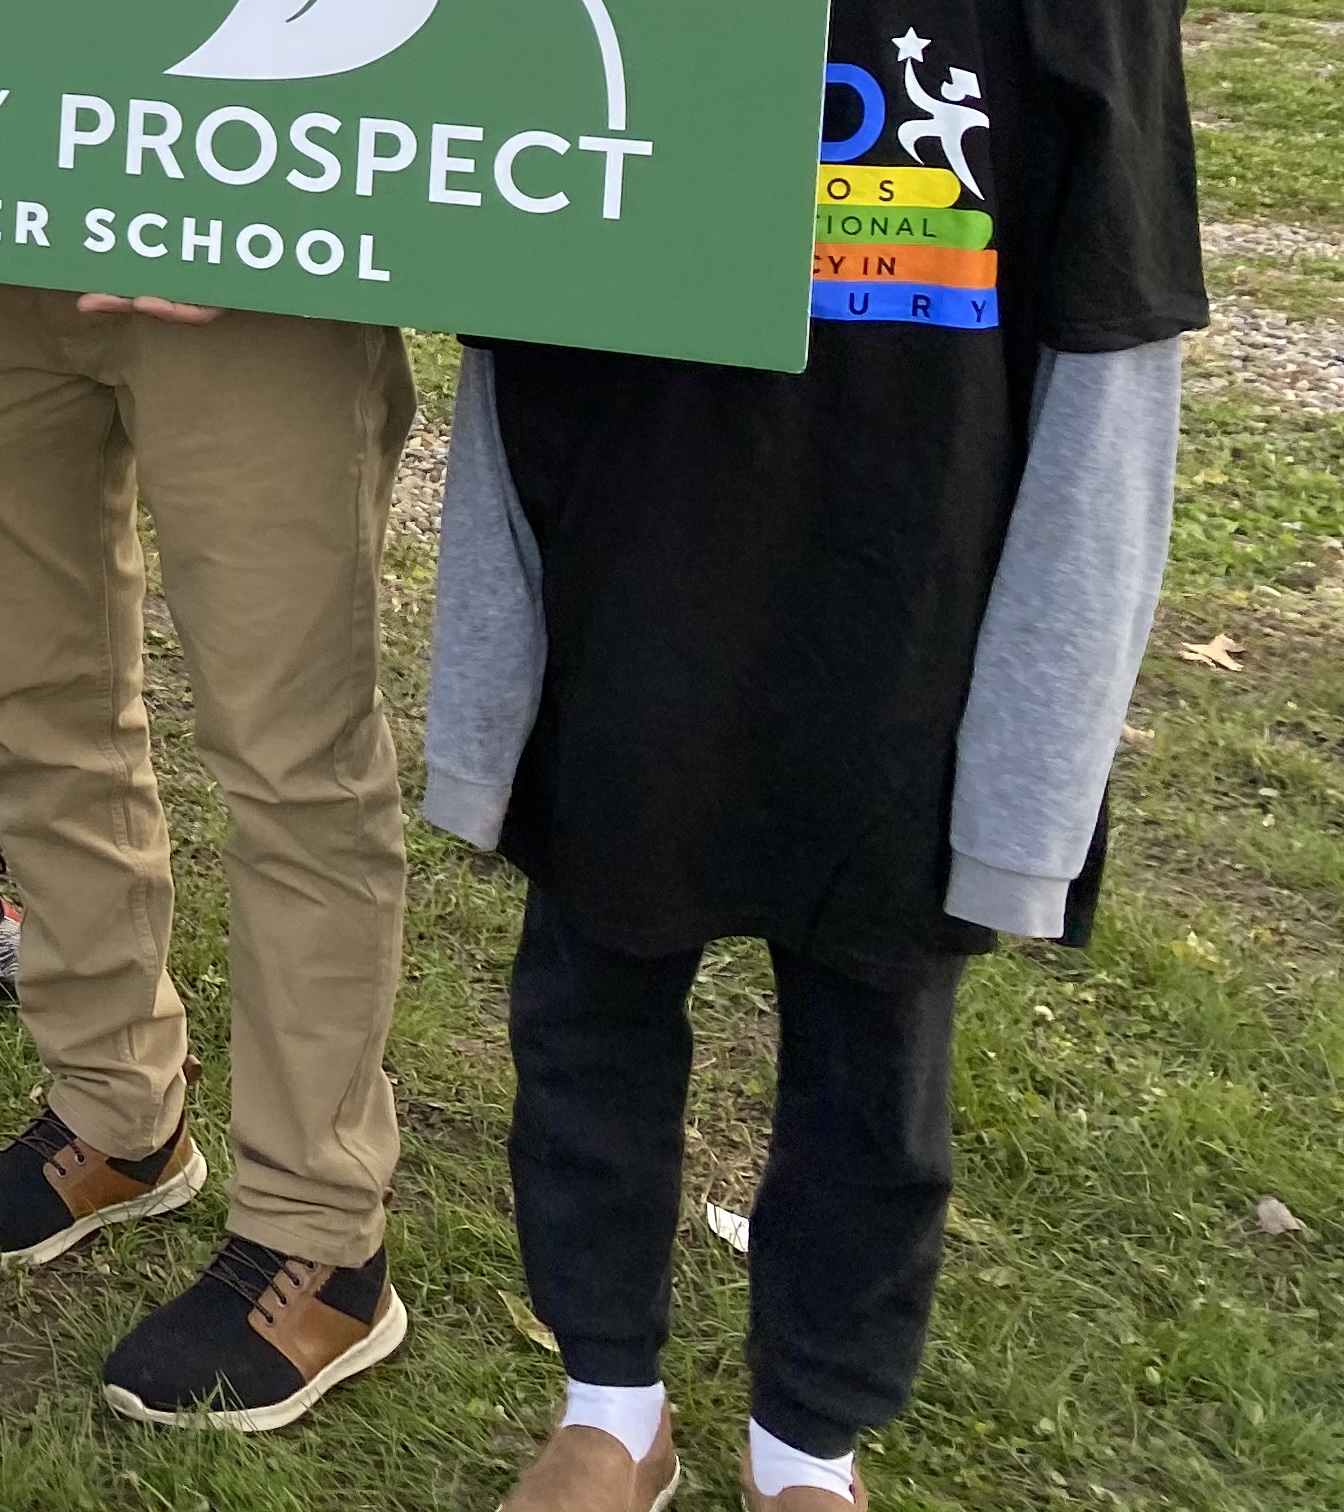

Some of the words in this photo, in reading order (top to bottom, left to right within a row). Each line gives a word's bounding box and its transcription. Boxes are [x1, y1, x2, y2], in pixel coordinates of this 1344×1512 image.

[57, 93, 653, 222] PROSPECT
[86, 208, 391, 284] SCHOOL
[863, 256, 896, 276] IN
